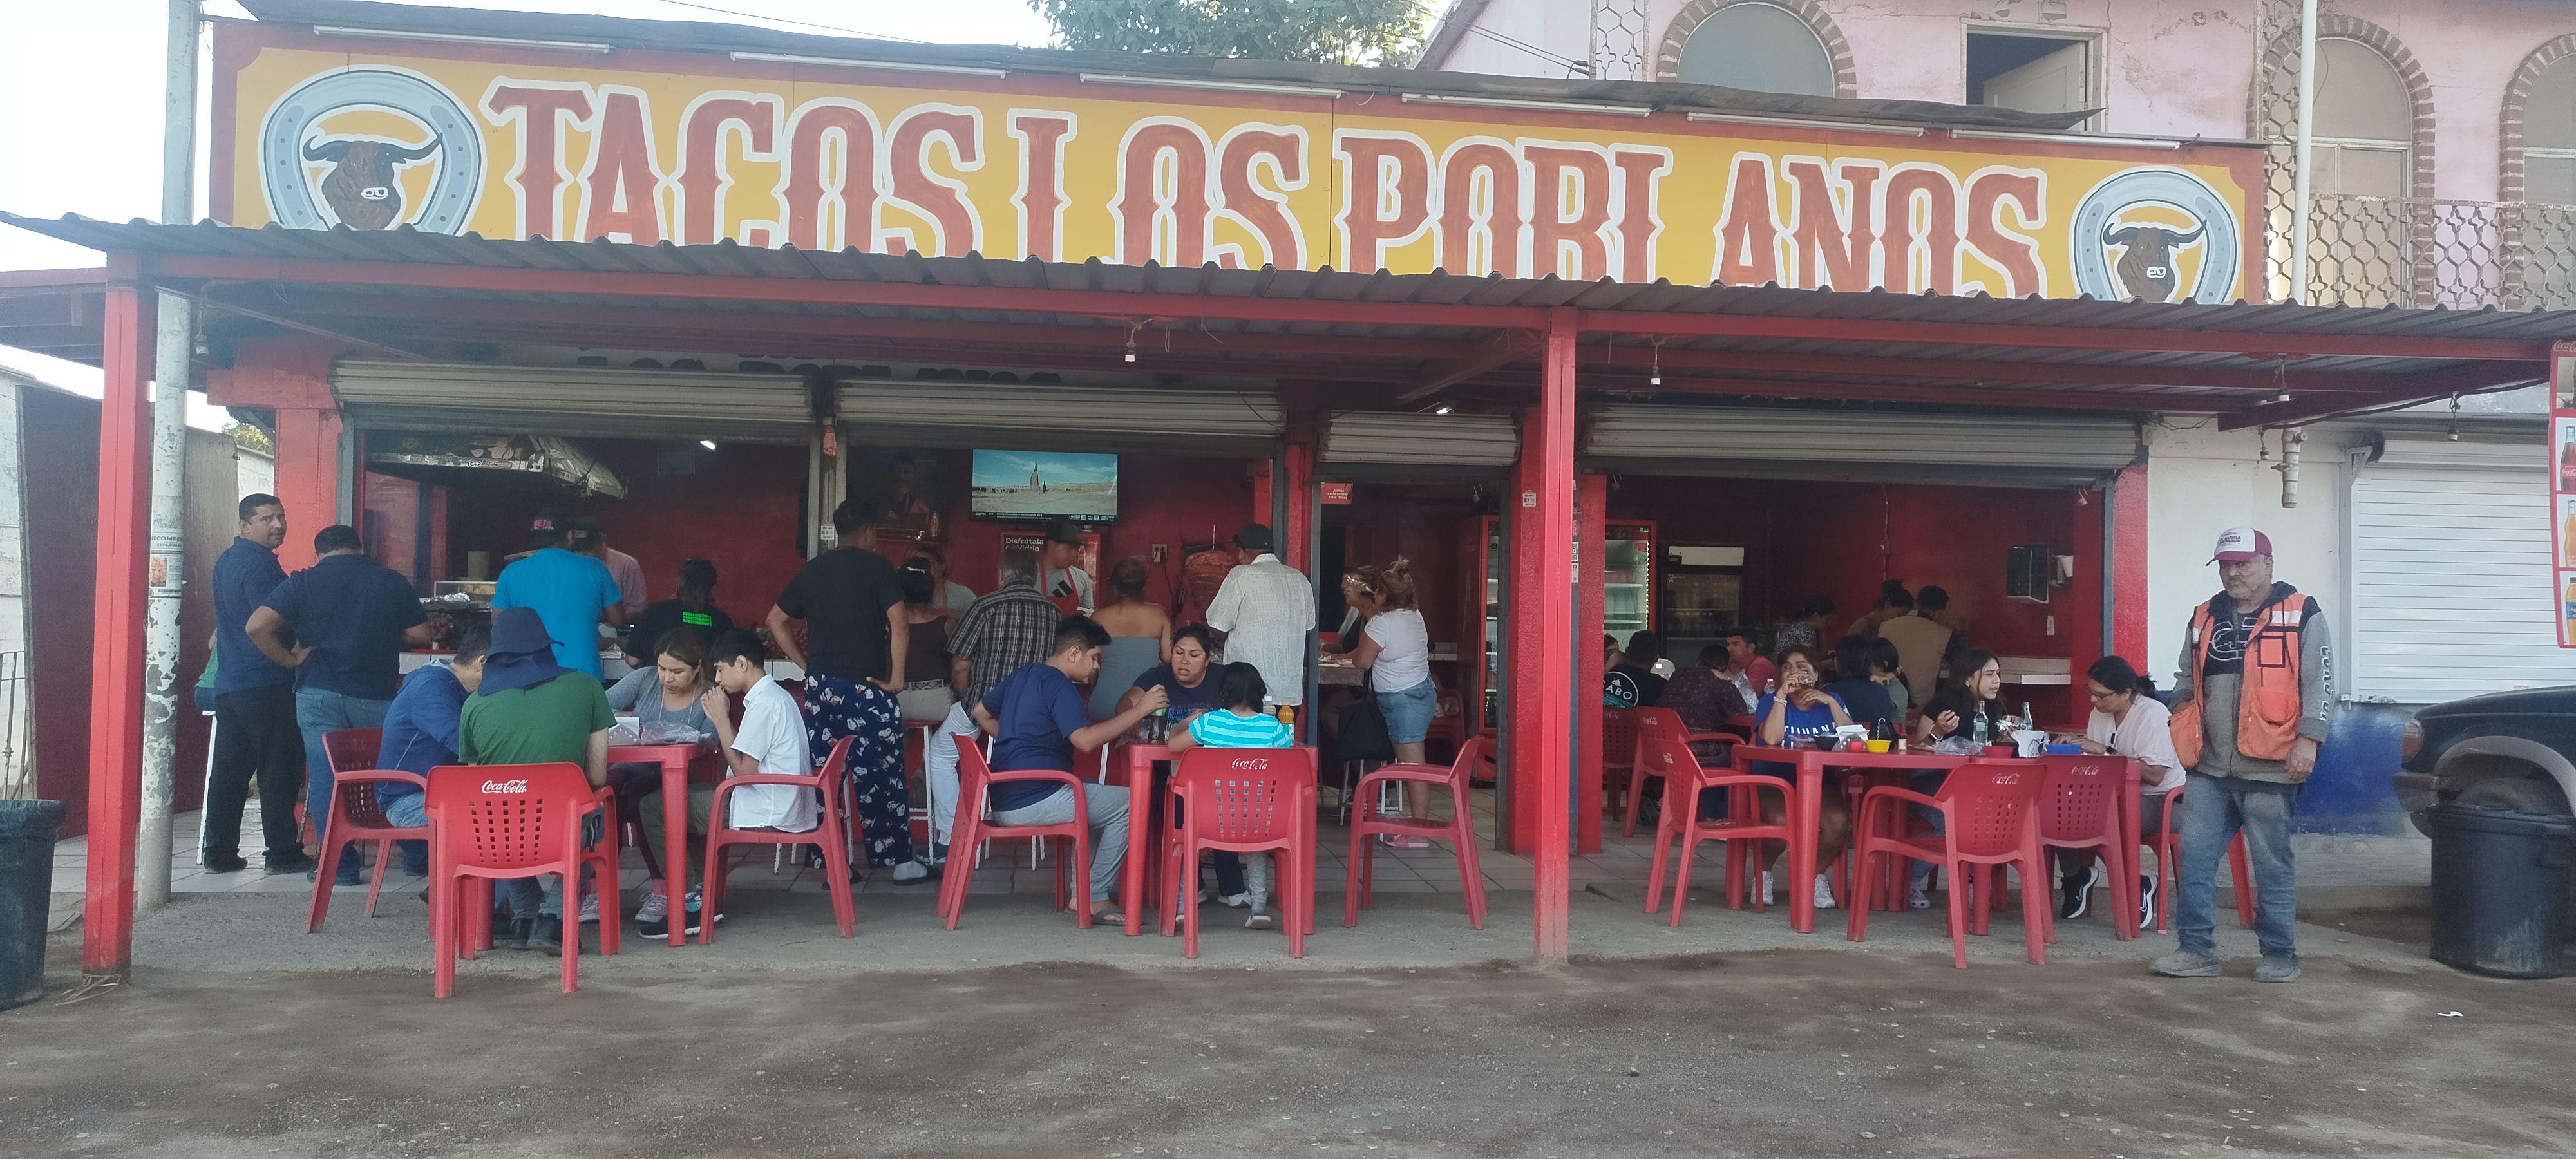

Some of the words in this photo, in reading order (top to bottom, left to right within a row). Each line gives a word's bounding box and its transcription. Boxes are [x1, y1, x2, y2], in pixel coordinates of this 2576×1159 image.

[480, 76, 985, 258] TACOS
[1603, 680, 1633, 700] ABO
[1232, 757, 1269, 770] Coca-Cola
[482, 779, 528, 794] Coca-Cola
